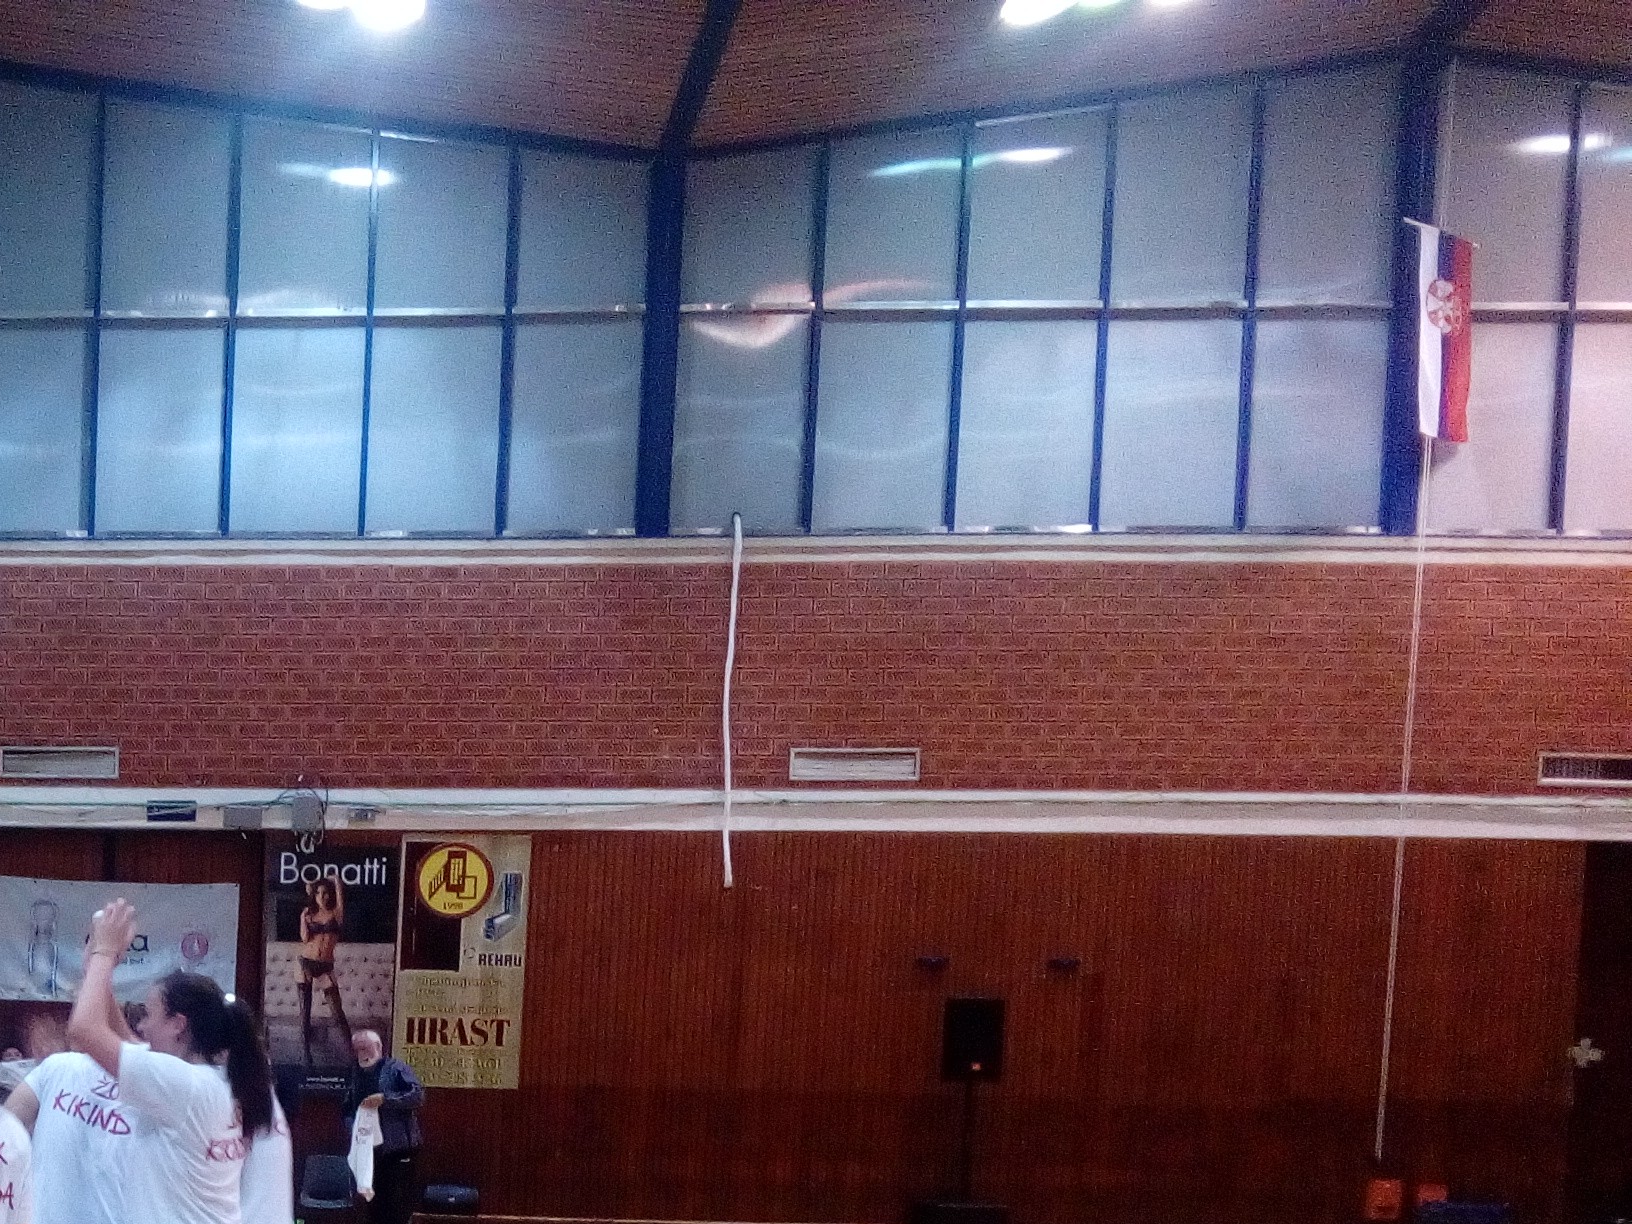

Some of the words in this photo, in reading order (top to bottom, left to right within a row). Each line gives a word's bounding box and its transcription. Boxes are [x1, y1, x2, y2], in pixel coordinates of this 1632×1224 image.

[280, 852, 388, 886] Bonatti
[477, 953, 523, 968] REHAU
[405, 1016, 511, 1047] HRAST
[52, 1088, 131, 1135] KIKIND
